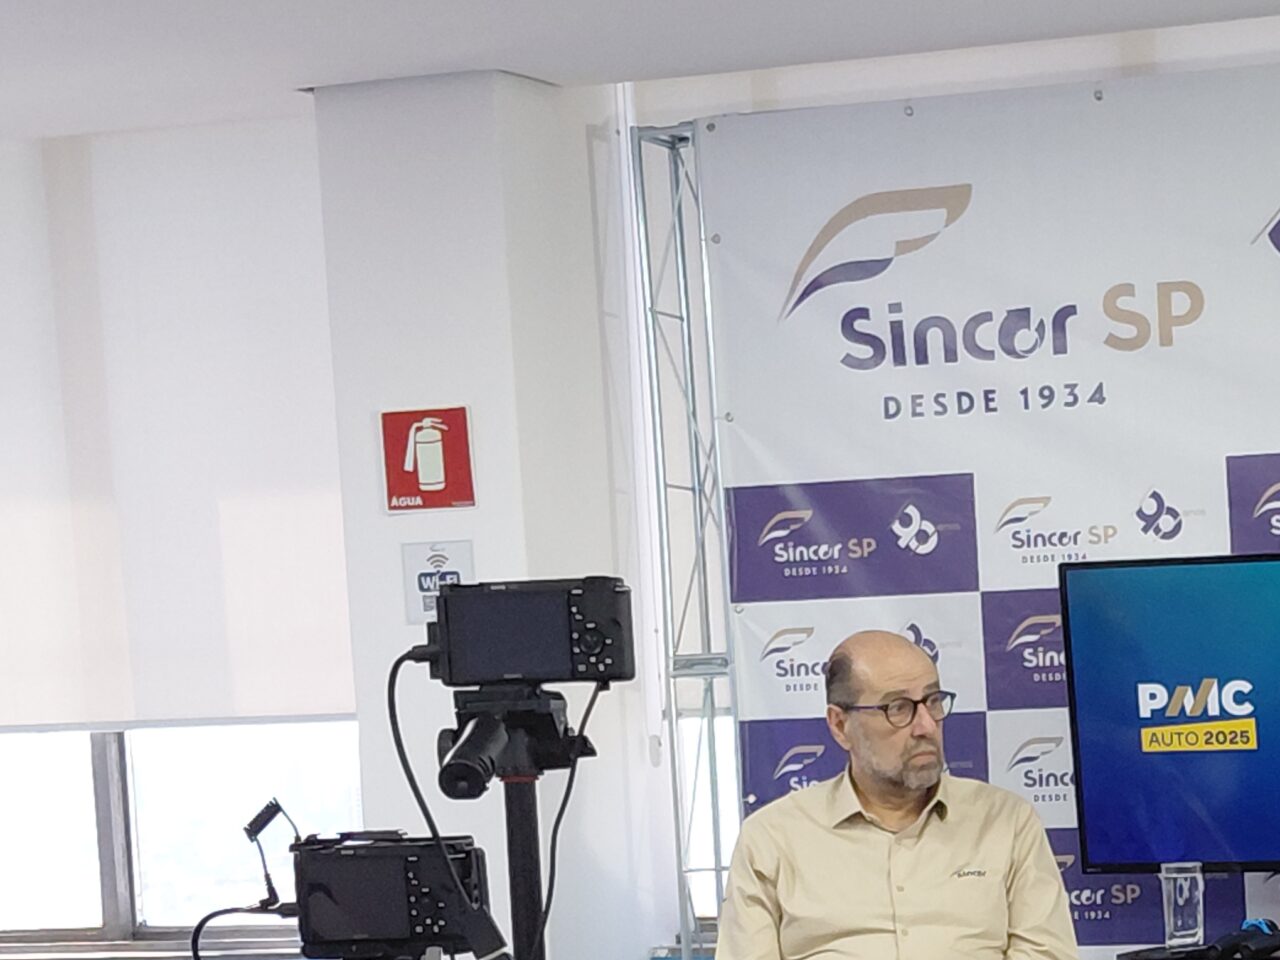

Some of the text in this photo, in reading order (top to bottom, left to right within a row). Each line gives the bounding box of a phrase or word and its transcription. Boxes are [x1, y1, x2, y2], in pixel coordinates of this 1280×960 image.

[839, 280, 1205, 371] Sincor SP
[882, 381, 1108, 421] DESDE 1934
[1136, 489, 1182, 541] 90
[891, 503, 939, 555] 90
[1011, 525, 1118, 550] Sincor SP
[774, 537, 877, 563] Sincor SP
[1022, 552, 1088, 564] DESDE 1934
[784, 566, 818, 577] DESDE
[776, 657, 830, 678] Sinc
[785, 682, 819, 692] DESDE
[1137, 677, 1255, 719] PMC
[1148, 729, 1251, 748] AUTO 2025
[1023, 769, 1076, 788] Sinc
[1033, 793, 1068, 803] DESDE
[1070, 884, 1141, 906] cor SP
[1084, 910, 1111, 920] 1934
